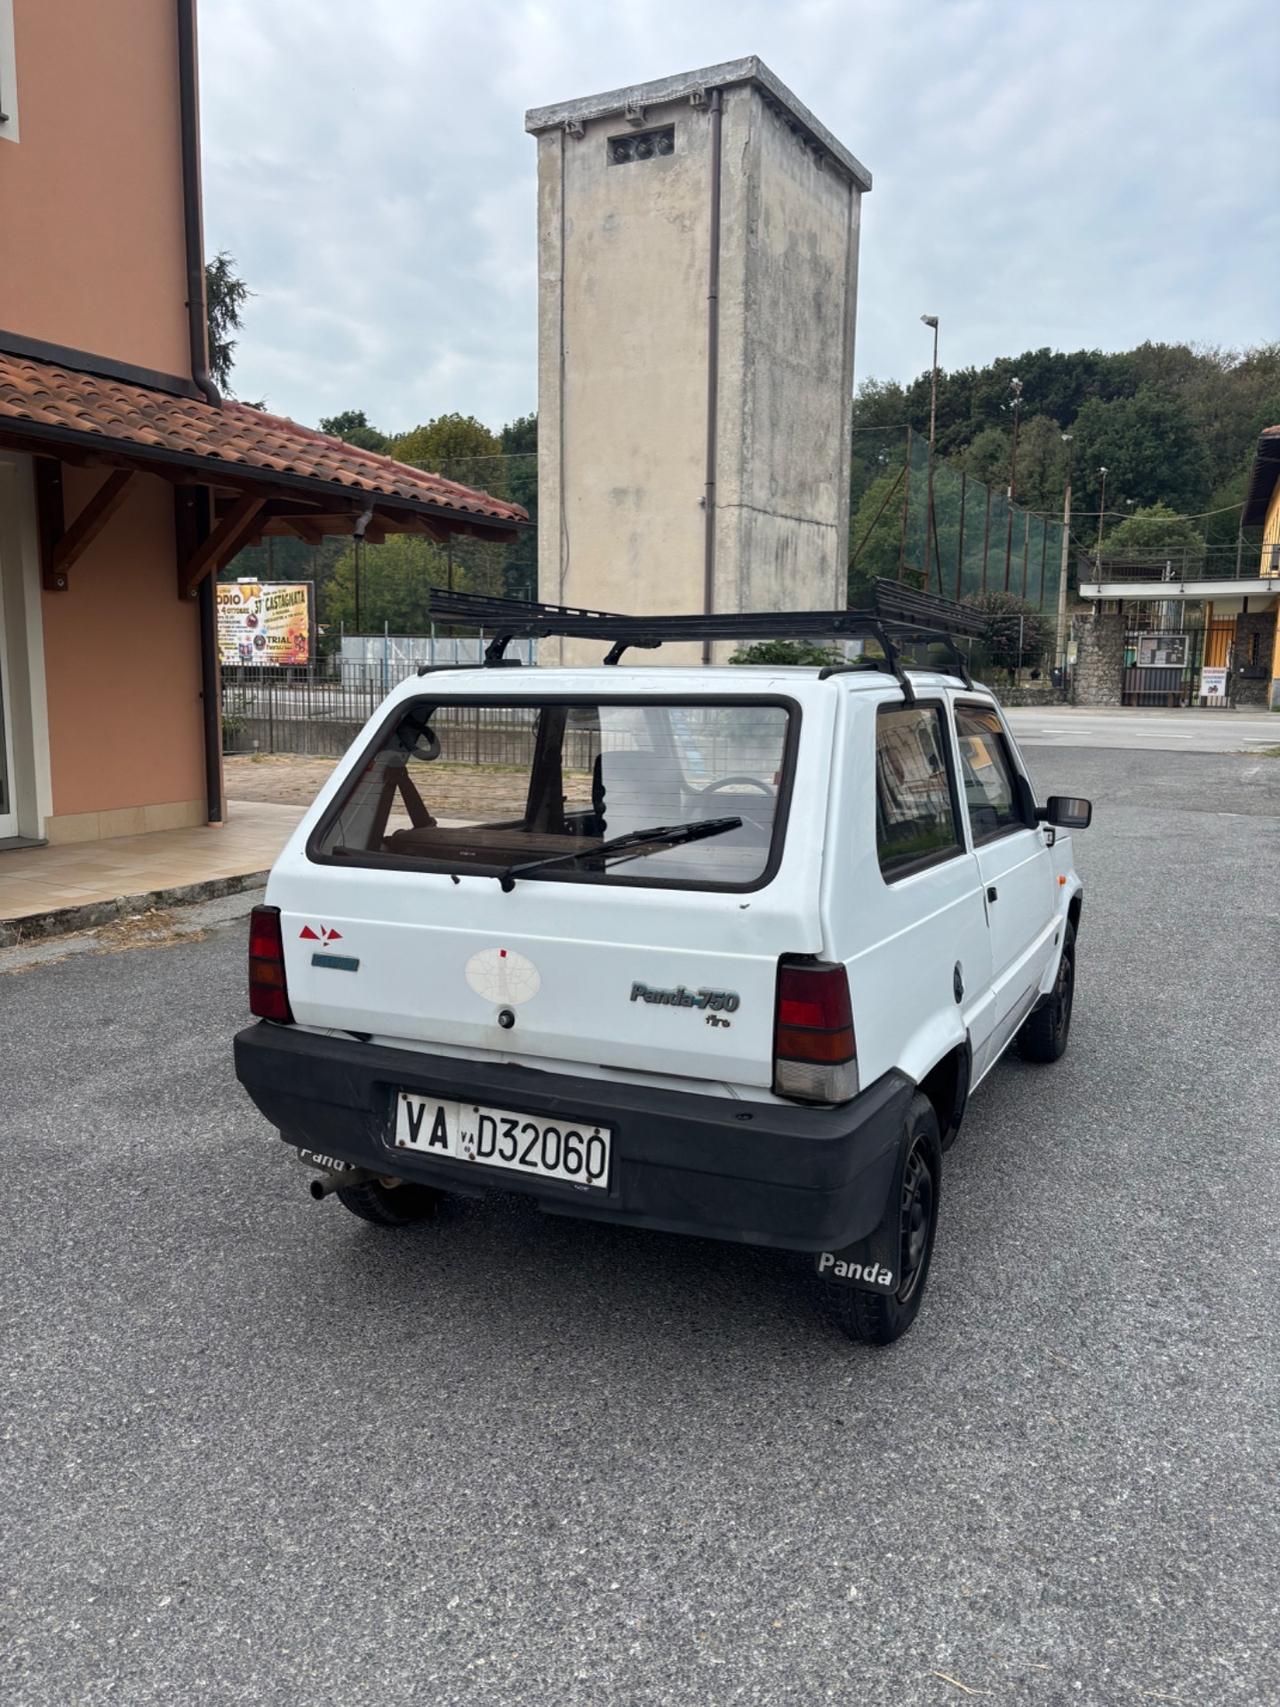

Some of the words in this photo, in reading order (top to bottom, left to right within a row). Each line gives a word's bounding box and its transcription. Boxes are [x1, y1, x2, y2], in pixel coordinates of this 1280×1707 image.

[266, 636, 292, 644] TRIAL
[630, 981, 694, 1008] Panda
[697, 987, 740, 1012] 750
[406, 1101, 448, 1149] VA
[477, 1114, 607, 1179] D32060
[460, 1131, 475, 1145] VA
[818, 1252, 893, 1286] Panda
